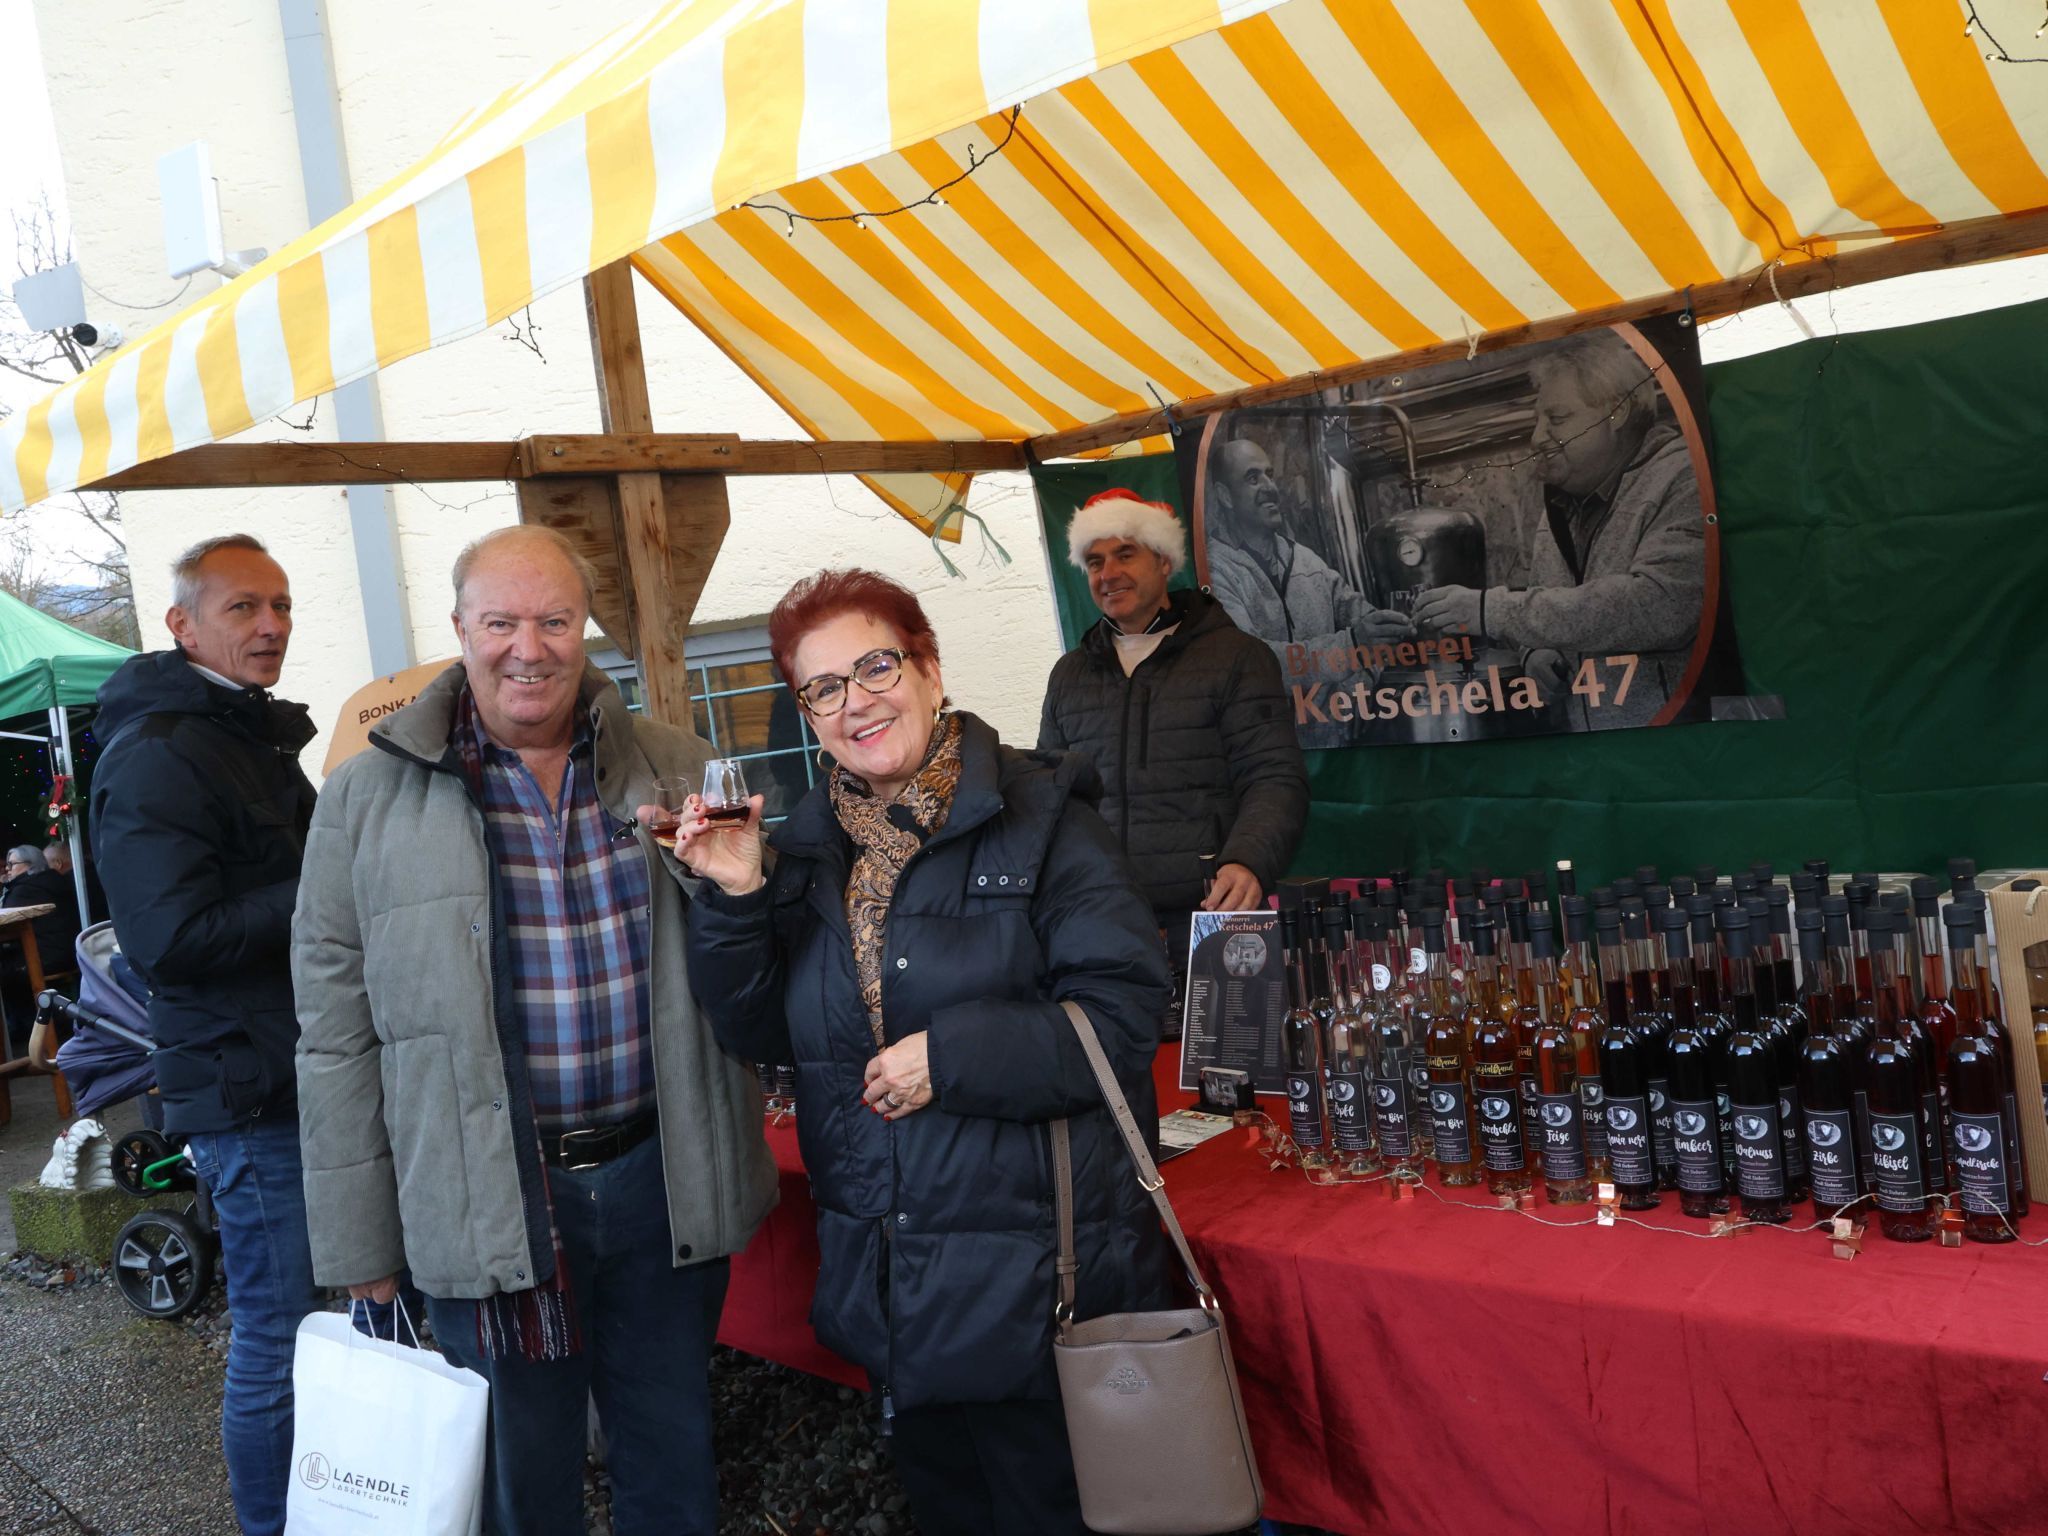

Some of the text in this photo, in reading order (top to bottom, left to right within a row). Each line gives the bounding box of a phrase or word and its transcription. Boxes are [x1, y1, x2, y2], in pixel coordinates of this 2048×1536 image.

[1285, 622, 1474, 678] Brennerei
[1291, 653, 1640, 726] Ketschela 47
[1220, 922, 1262, 931] Ketschela
[1582, 1108, 1603, 1123] Feige
[1546, 1129, 1570, 1145] Feige
[1735, 1143, 1774, 1160] Walnuss
[1813, 1150, 1839, 1166] Zirbe
[333, 1467, 410, 1498] LAENDLE
[332, 1482, 408, 1507] LASERTECHNIK
